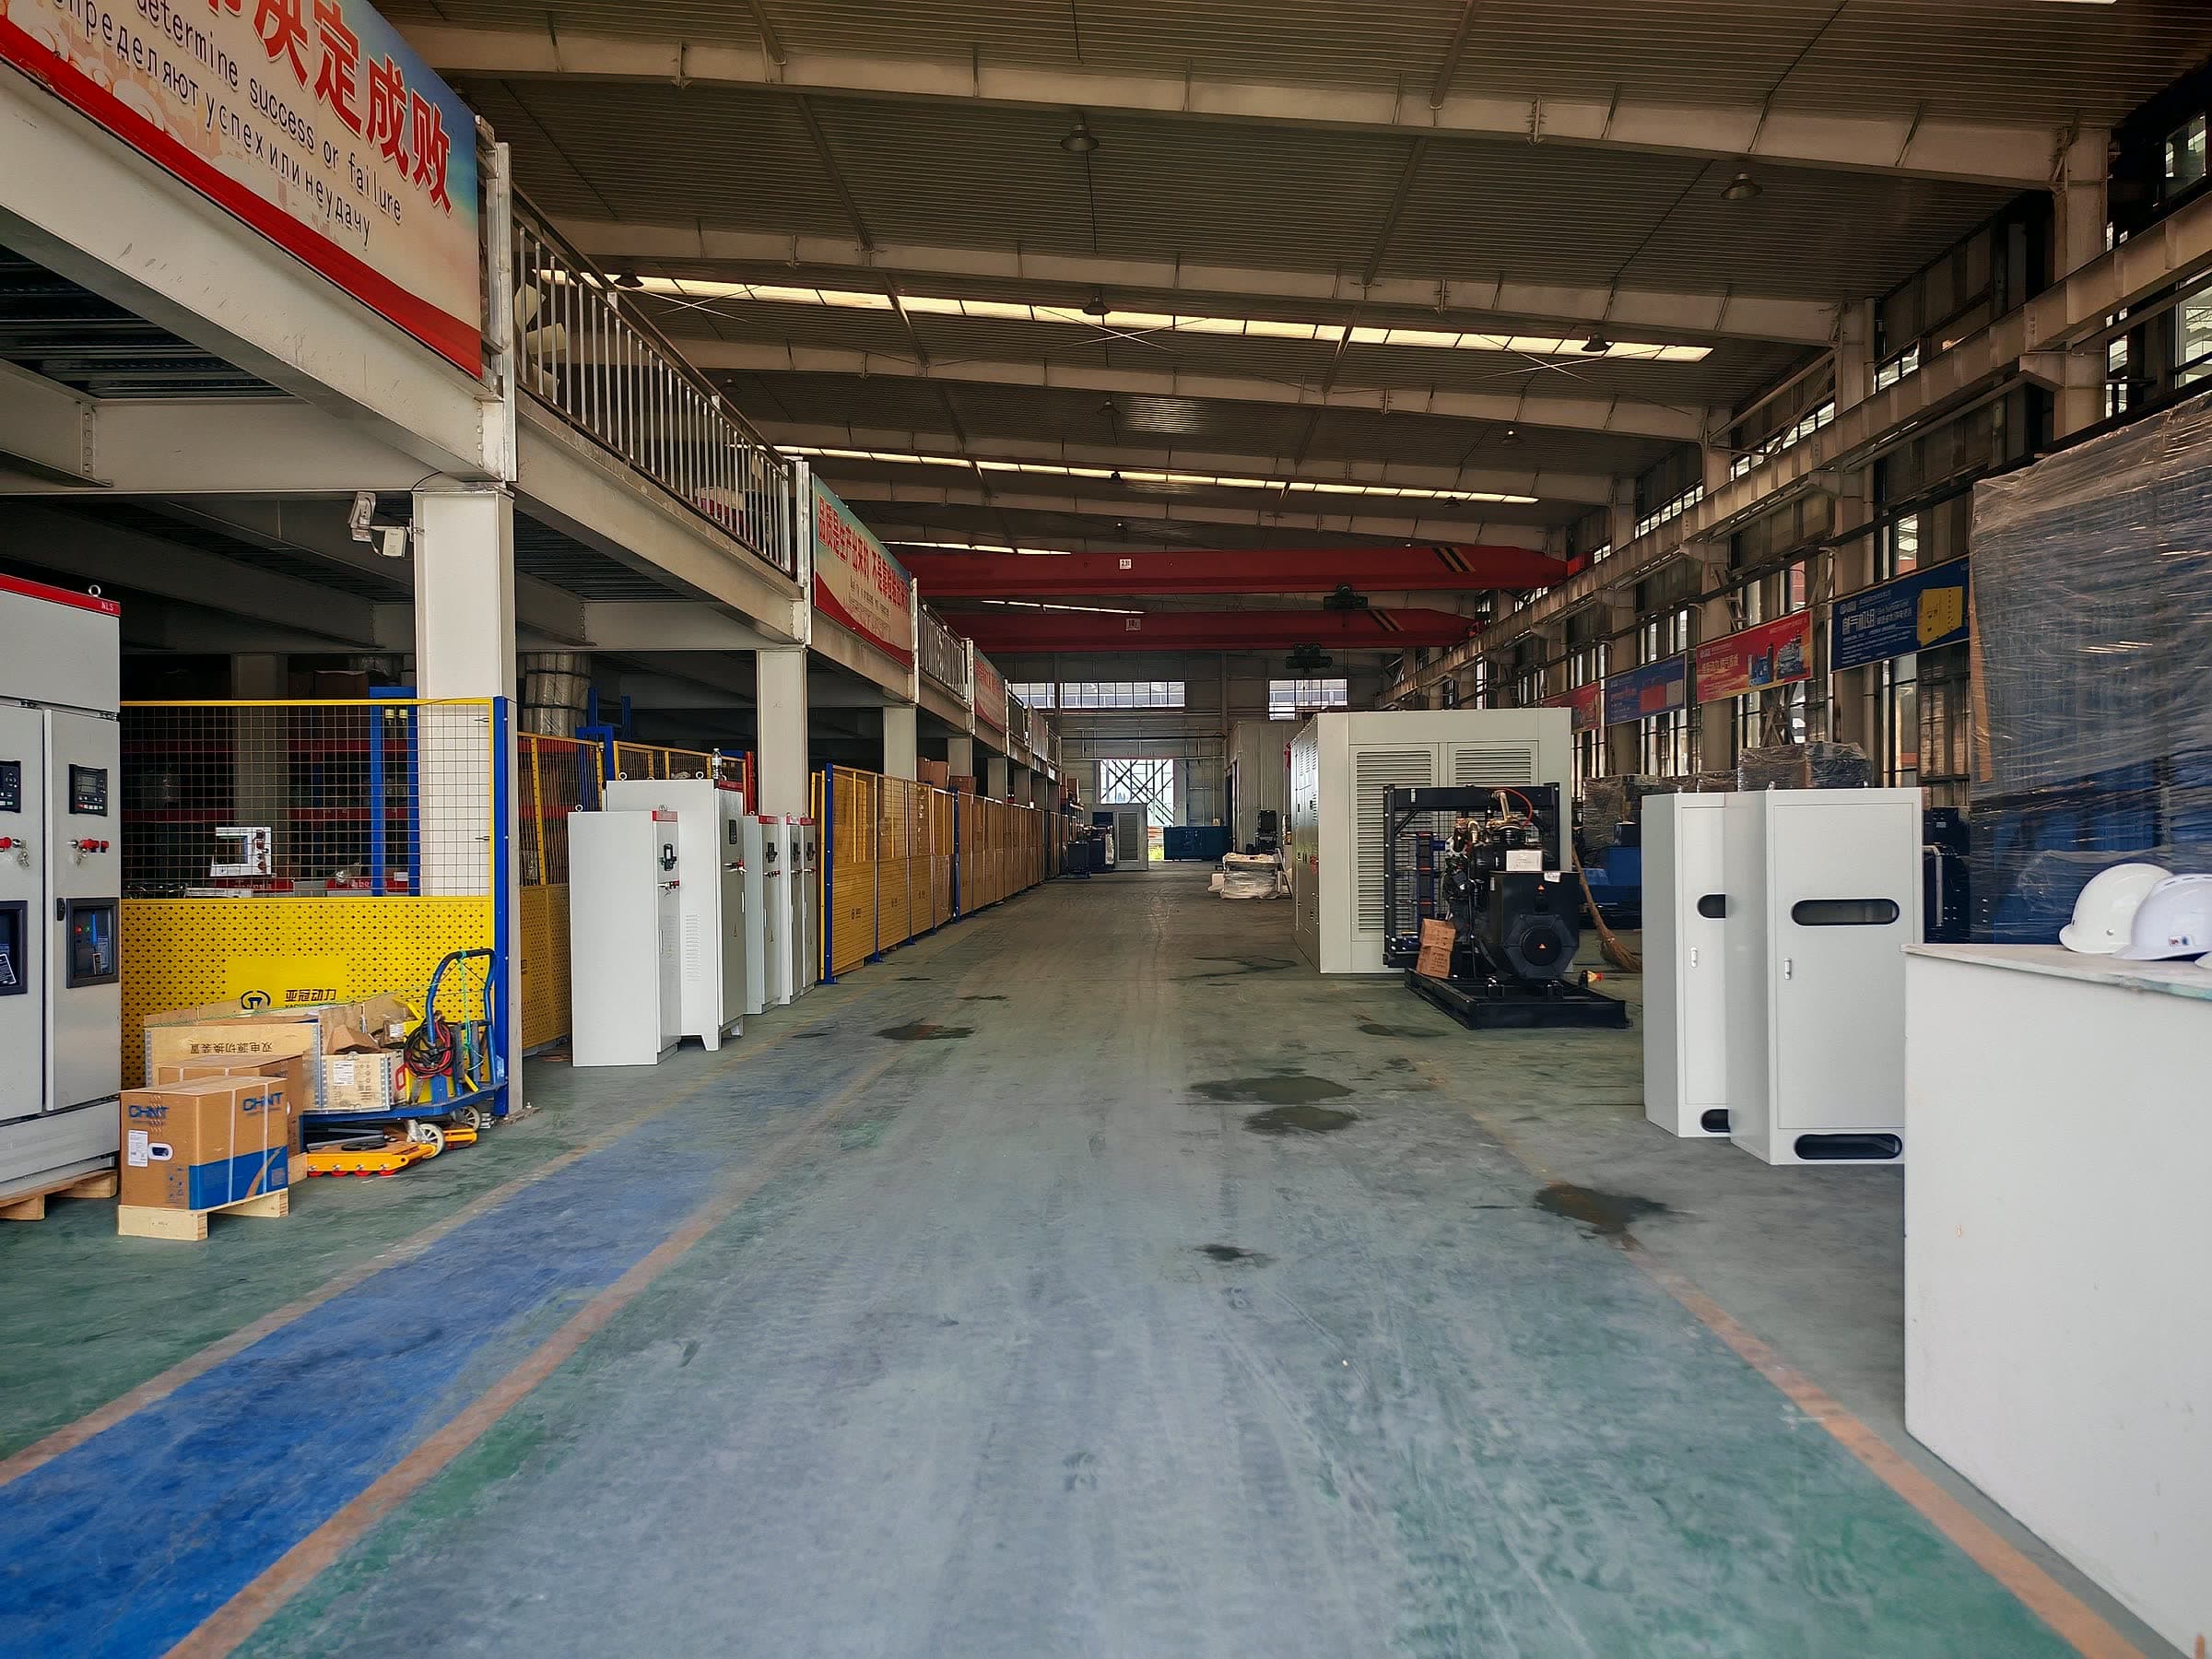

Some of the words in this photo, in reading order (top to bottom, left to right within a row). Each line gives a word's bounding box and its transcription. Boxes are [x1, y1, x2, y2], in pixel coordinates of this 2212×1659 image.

[205, 92, 264, 157] успех
[269, 142, 300, 185] или
[305, 170, 371, 245] неудачу
[206, 0, 452, 217] 决定成败
[249, 76, 315, 150] success
[323, 140, 339, 169] or
[347, 152, 401, 221] failure
[190, 1041, 274, 1054] 双电源切换装置
[285, 989, 337, 1003] 亚冠动力
